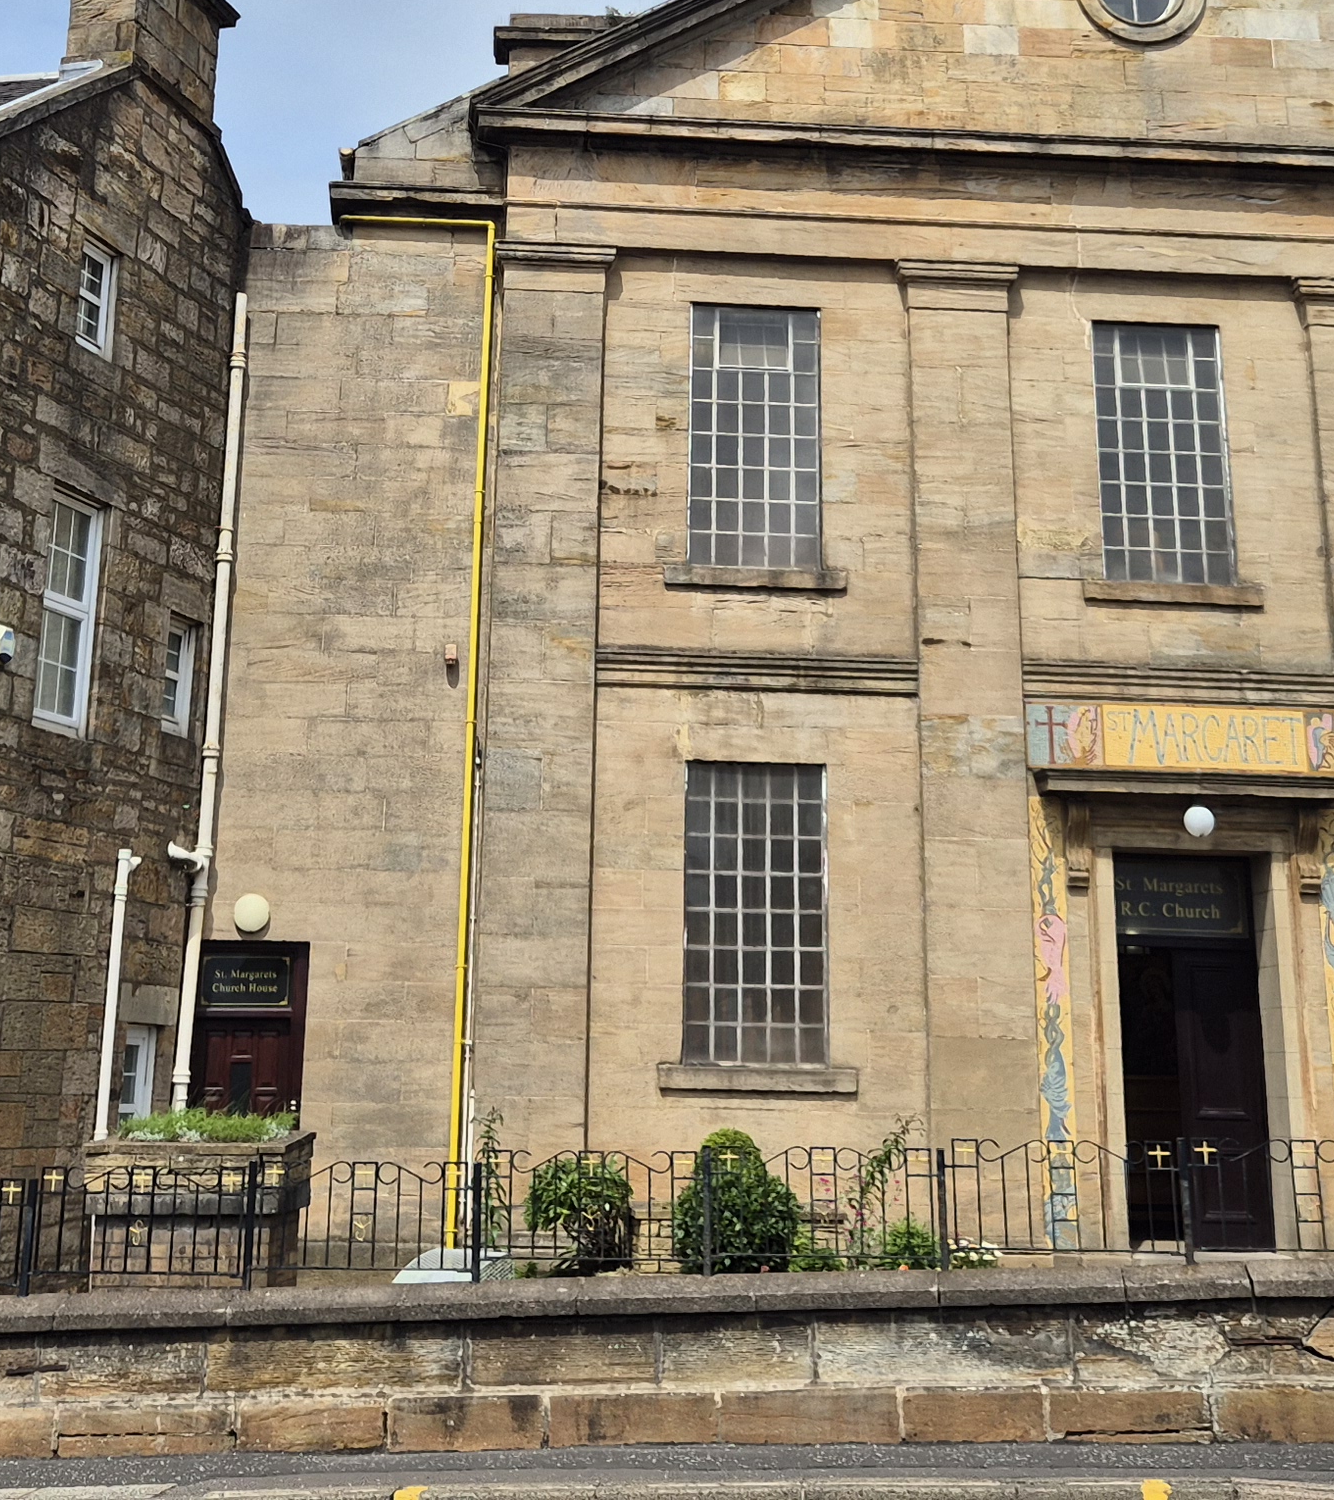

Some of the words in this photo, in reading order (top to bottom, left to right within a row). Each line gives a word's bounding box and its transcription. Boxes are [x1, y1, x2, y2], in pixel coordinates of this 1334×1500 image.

[1128, 708, 1302, 766] MARGARET
[1142, 877, 1224, 897] Margarets
[1120, 901, 1157, 917] R.C.
[1162, 902, 1221, 919] Church
[230, 968, 278, 981] Margarets
[211, 982, 246, 993] Church
[248, 982, 278, 993] House
